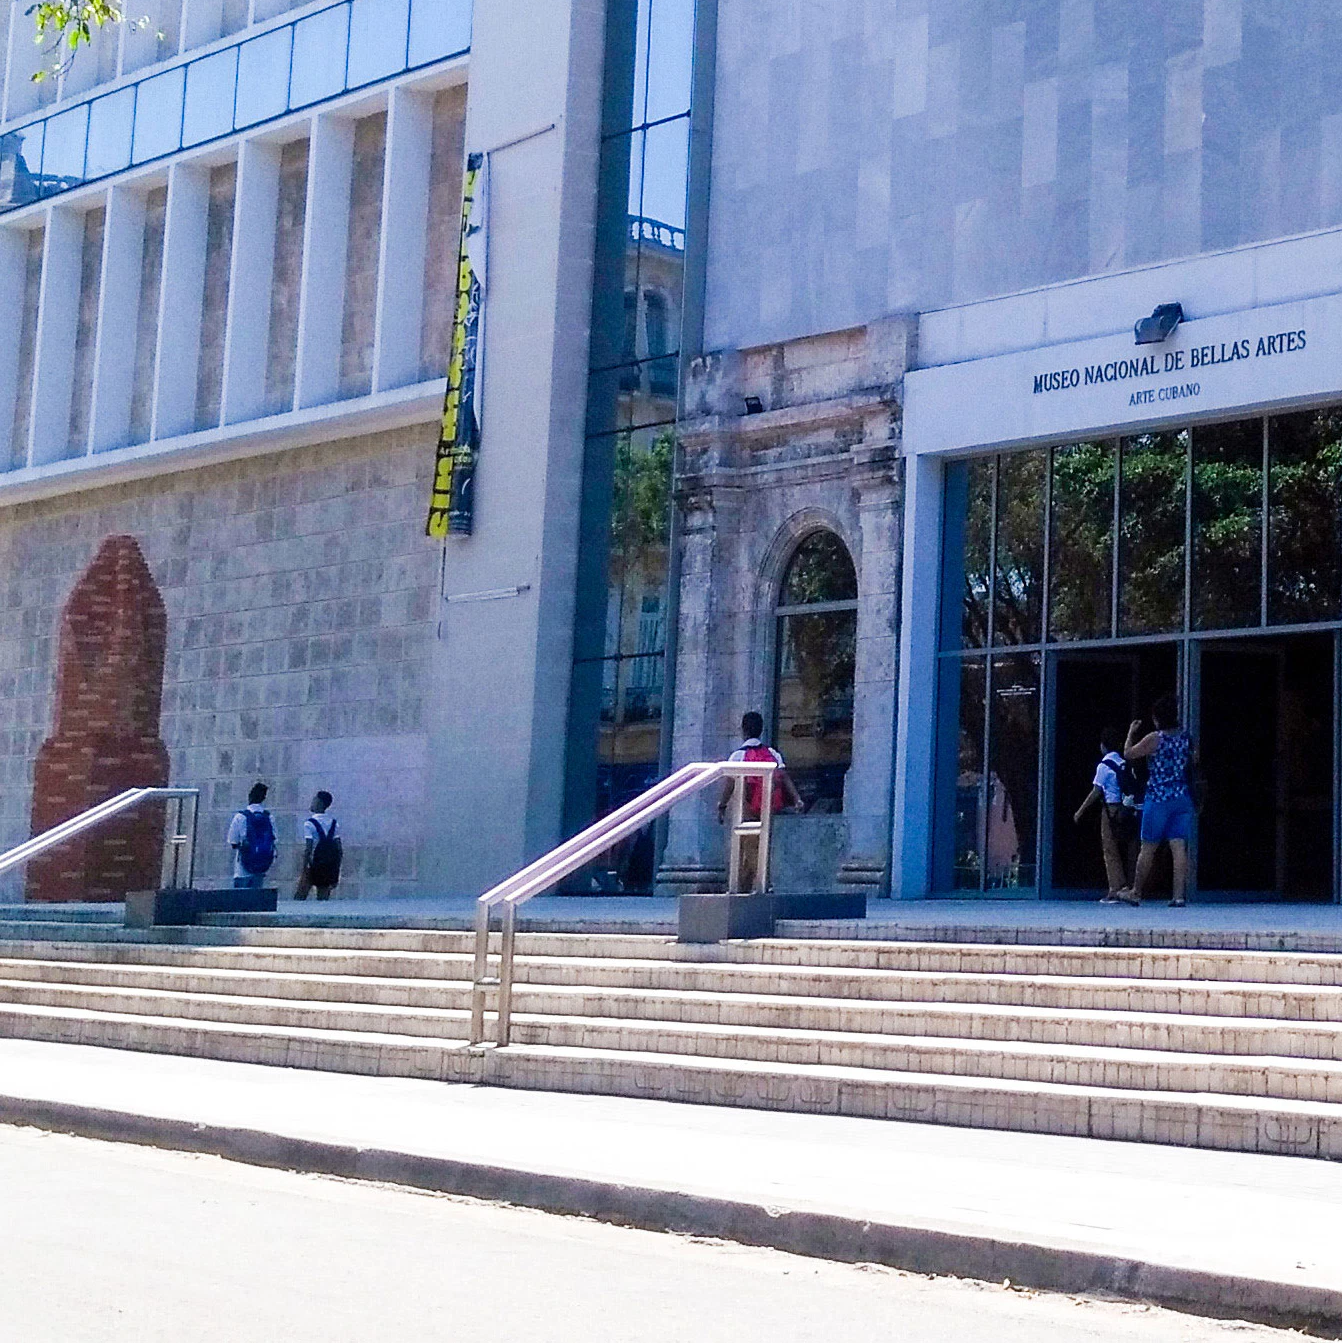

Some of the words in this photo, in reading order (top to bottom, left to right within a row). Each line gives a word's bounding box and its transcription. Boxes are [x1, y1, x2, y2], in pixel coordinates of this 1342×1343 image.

[1033, 367, 1081, 394] MUSEO
[1084, 354, 1160, 385] NACIONAL
[1164, 350, 1185, 373] DE
[1190, 339, 1250, 368] BELLAS
[1255, 329, 1307, 357] ARTES
[1128, 389, 1155, 406] ARTE
[1158, 382, 1201, 402] CUBANO
